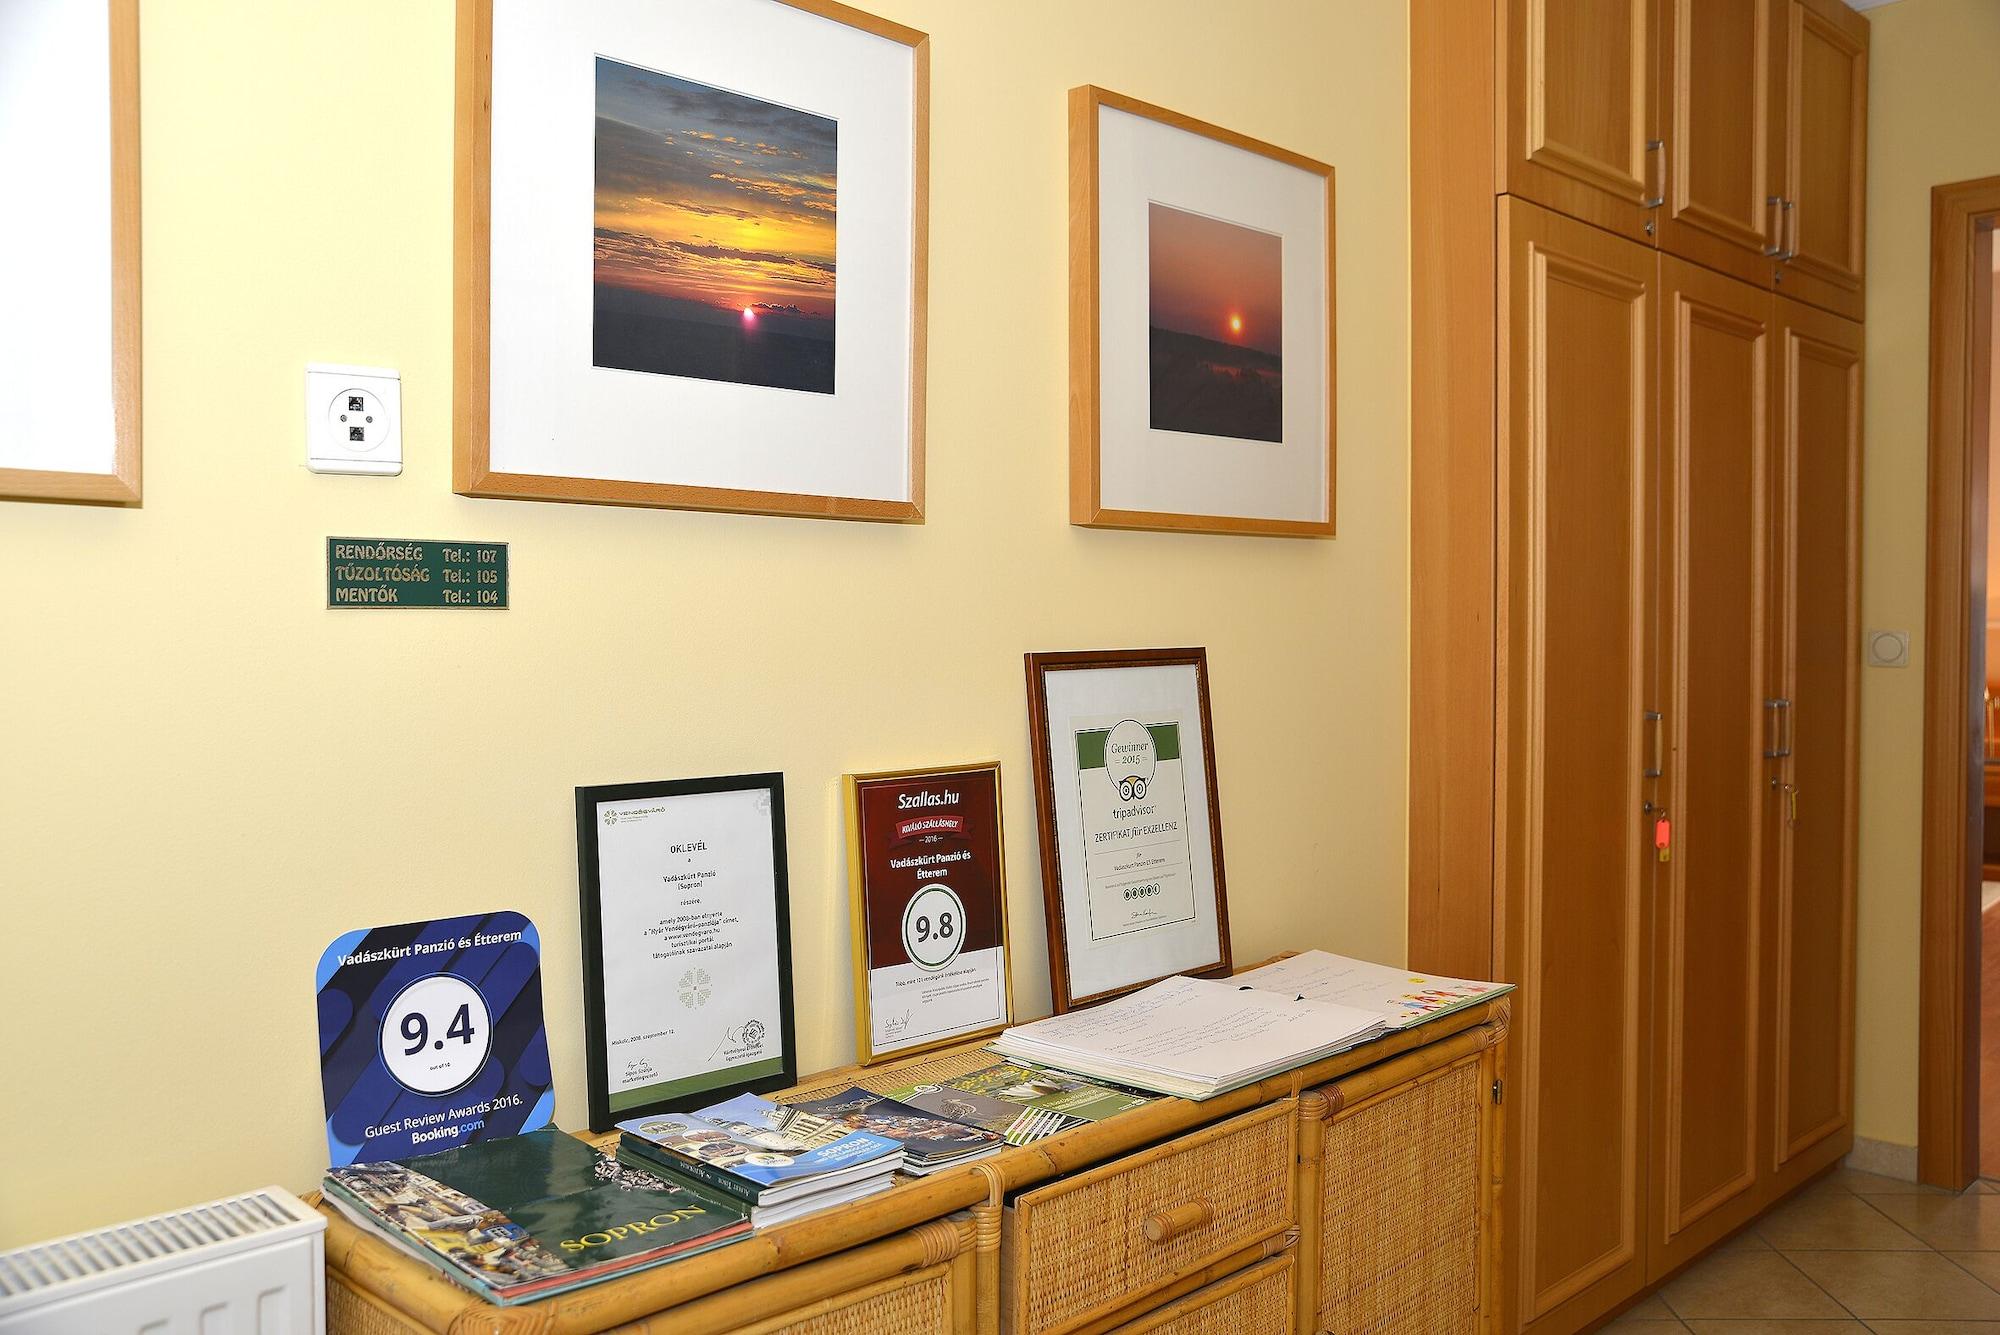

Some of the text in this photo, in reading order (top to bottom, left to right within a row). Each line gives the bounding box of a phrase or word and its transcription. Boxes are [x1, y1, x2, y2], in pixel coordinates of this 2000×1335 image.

[335, 542, 497, 563] RENDŐRSÉG Tel.: 107
[335, 563, 498, 583] TŰZOLTÓSÁG Tel.: 105
[336, 585, 498, 604] MENTŐK Tel.: 104
[1111, 742, 1149, 754] Gewinner
[1122, 754, 1141, 765] 2015
[898, 789, 960, 810] Szallas.hu
[1113, 805, 1155, 821] tripadvisor
[1095, 821, 1177, 843] ZERTIFIKAT für EXZELLENZ
[670, 840, 707, 854] OKLEVÉL
[890, 850, 971, 869] Vadászkürt Panzió és
[916, 868, 948, 880] Étterem
[915, 911, 954, 943] 9.8
[337, 930, 522, 967] Vadászkürt Panzió és Étterem
[400, 1003, 475, 1056] 9.4
[364, 1094, 523, 1139] Guest Review Awards 2016.
[411, 1118, 485, 1145] Booking.com
[817, 1136, 870, 1157] SOPRON
[560, 1203, 706, 1253] SOPRON
